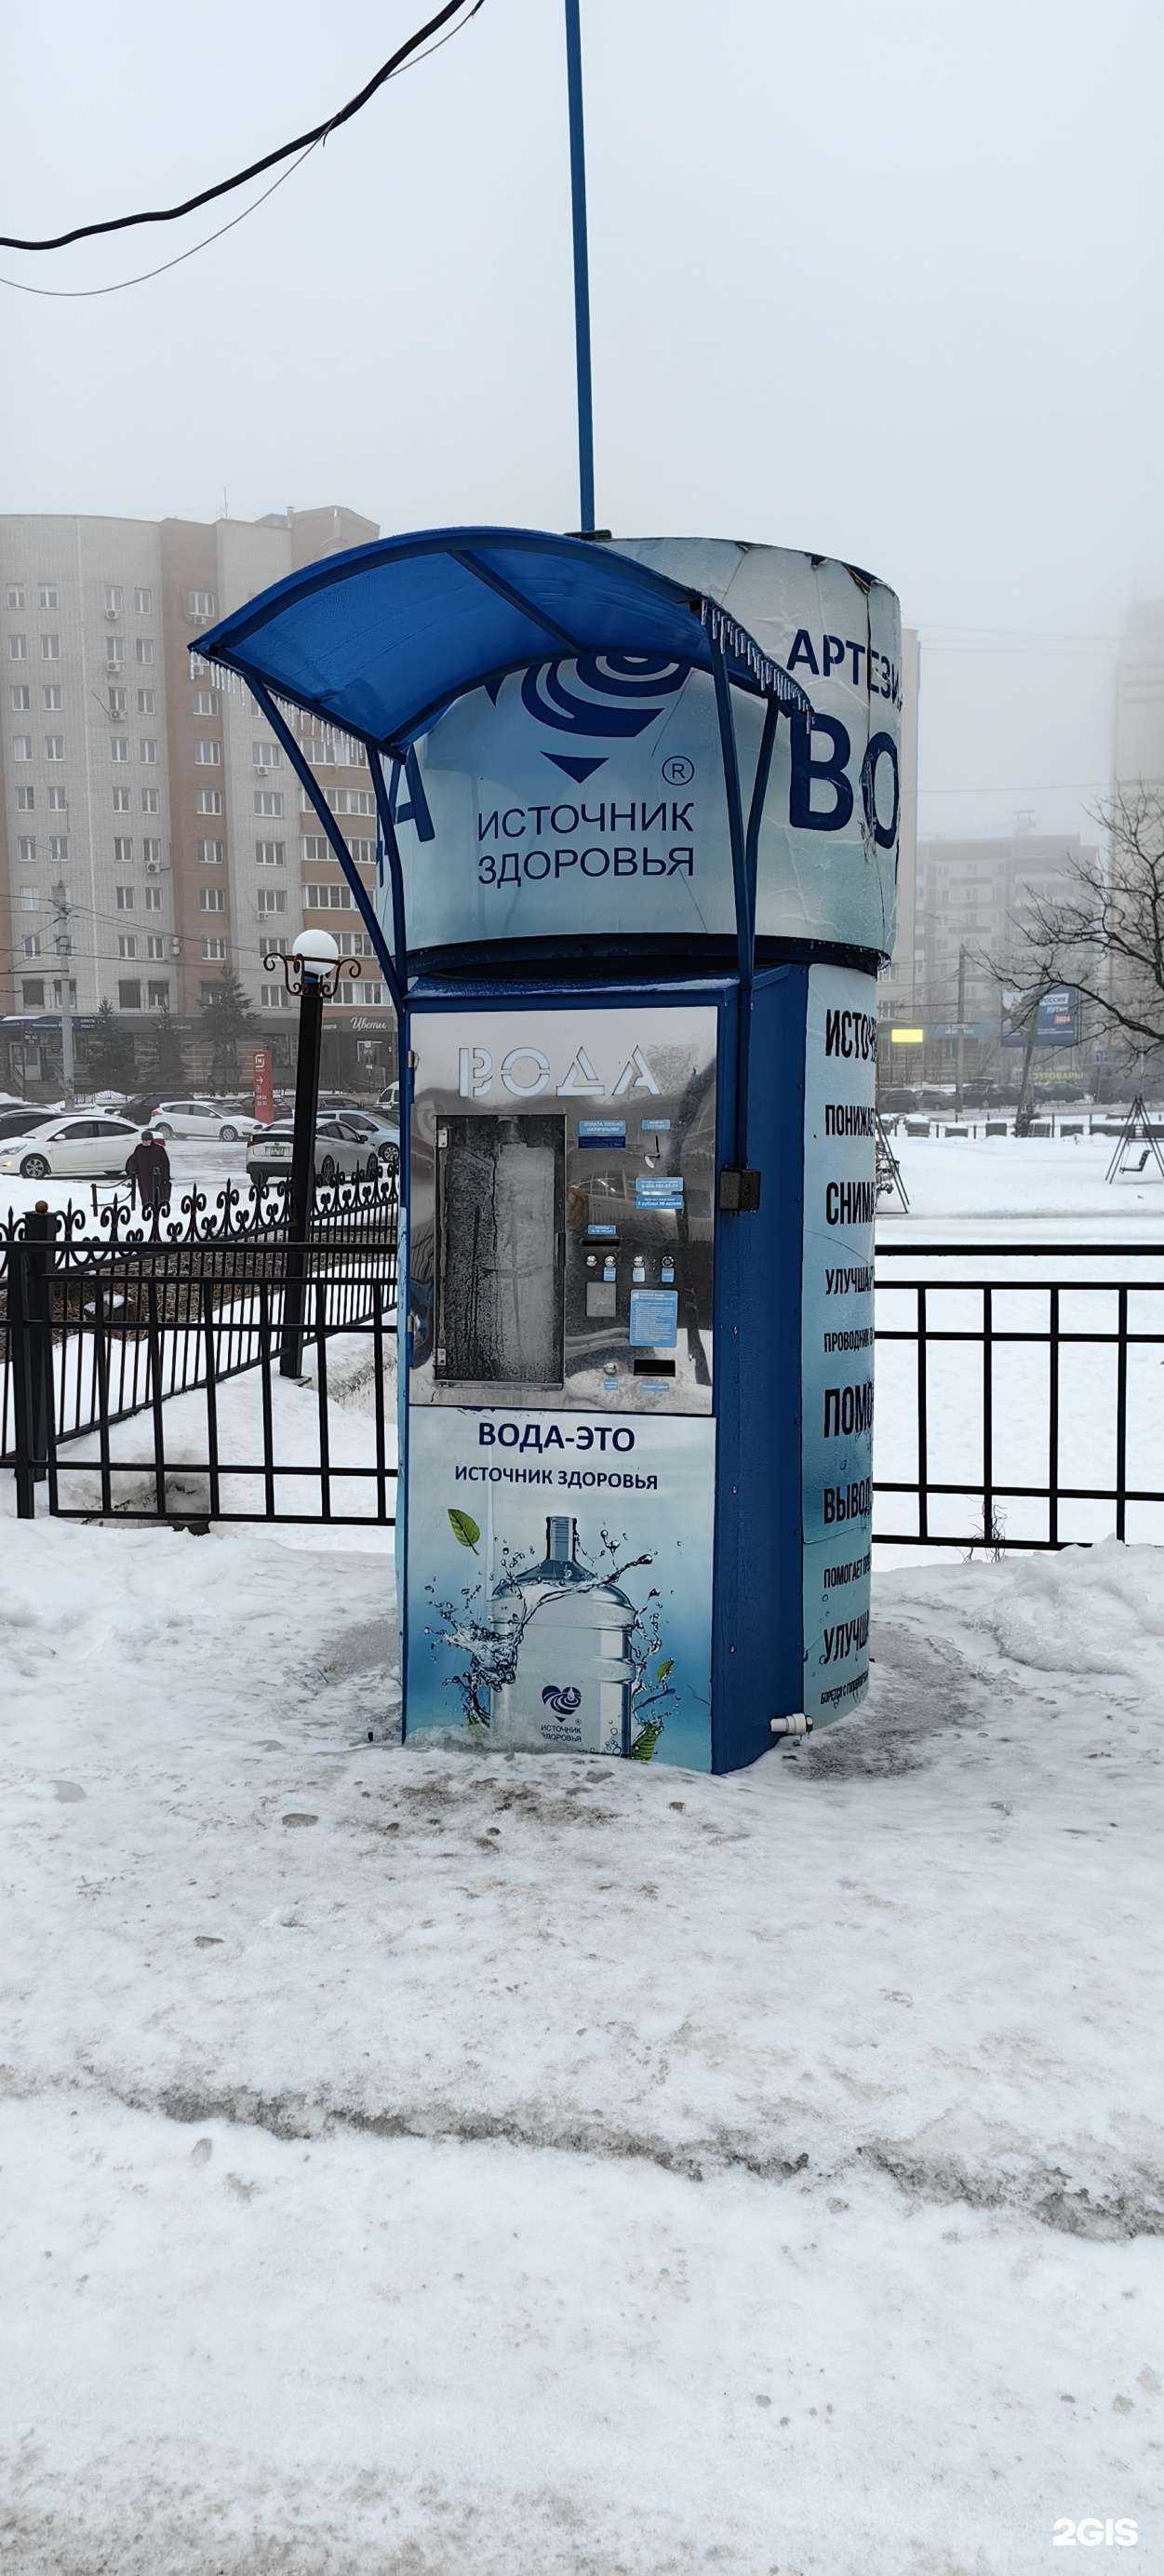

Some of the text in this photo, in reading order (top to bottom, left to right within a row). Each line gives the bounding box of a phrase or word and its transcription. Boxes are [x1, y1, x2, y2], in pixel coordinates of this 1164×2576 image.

[477, 802, 695, 841] ИСТОЧНИК
[477, 847, 695, 888] ЗДОРОВЬЯ
[459, 1043, 662, 1097] ВОДА
[478, 1422, 636, 1454] ВОДА-ЭТО
[454, 1465, 659, 1490] ИСТОЧНИК ЗДОРОВЬЯ
[824, 1559, 863, 1588] ПОМОГАЕТ
[541, 1724, 582, 1734] ИСТОЧНИК
